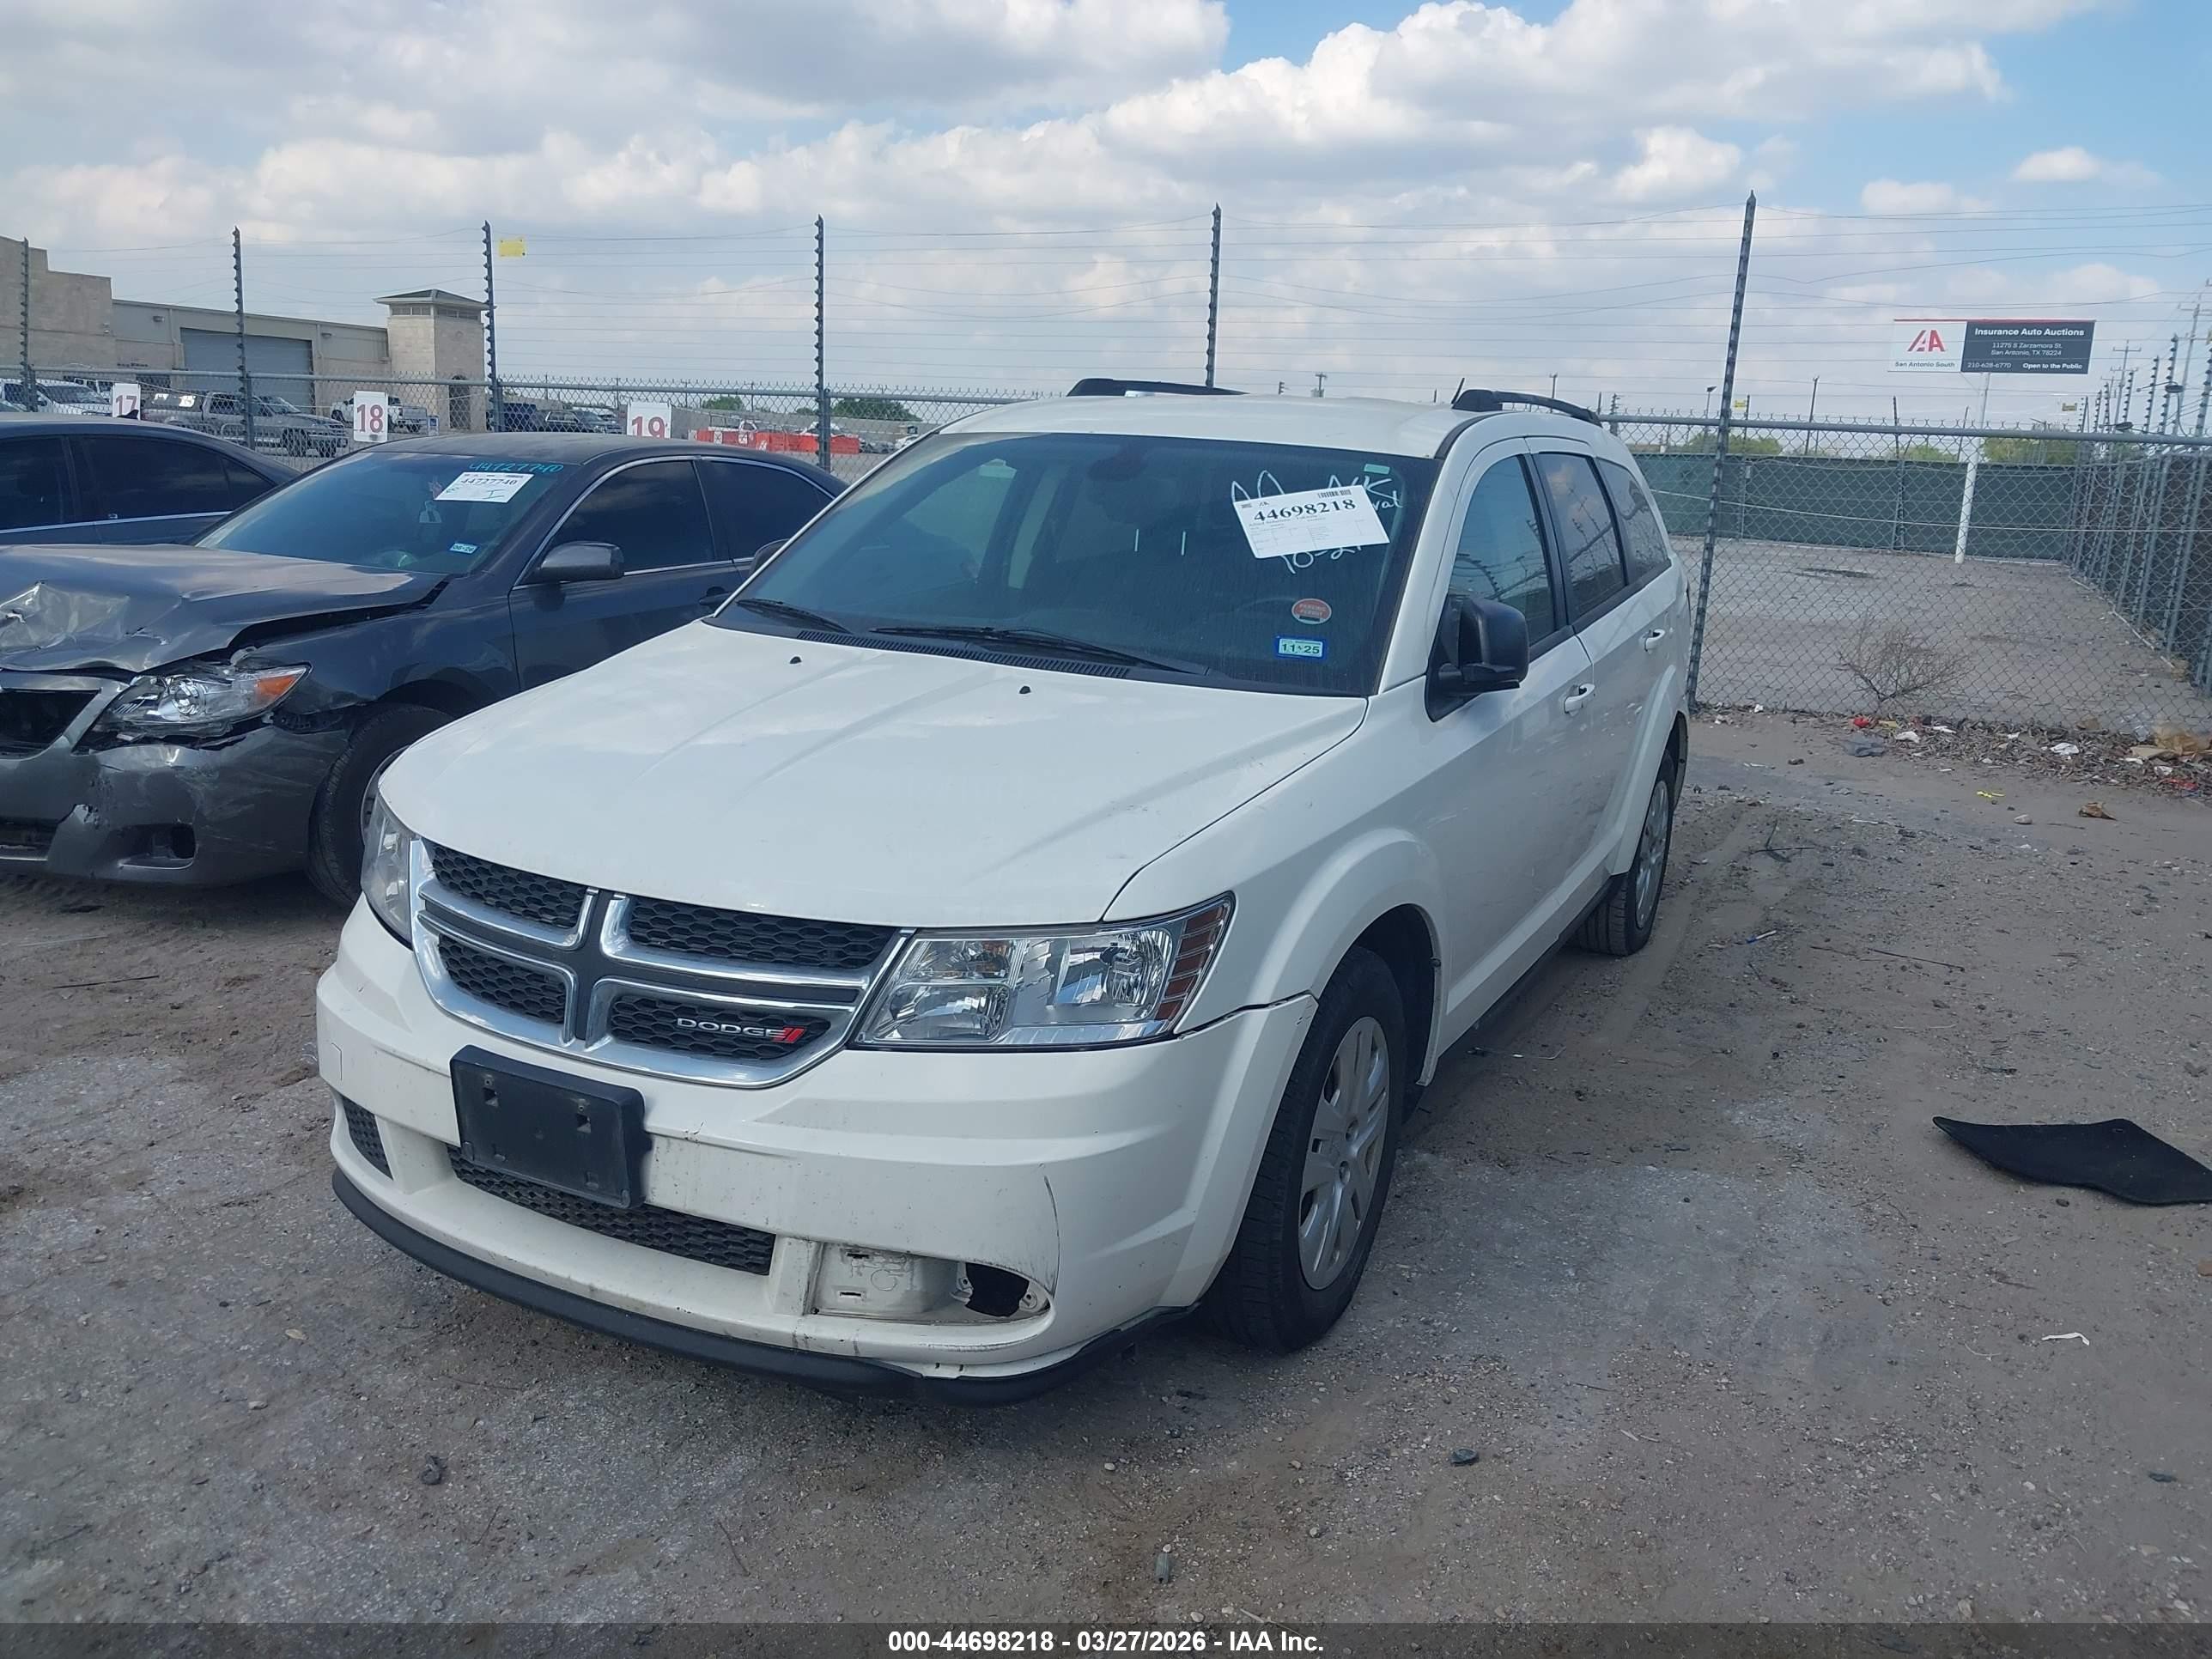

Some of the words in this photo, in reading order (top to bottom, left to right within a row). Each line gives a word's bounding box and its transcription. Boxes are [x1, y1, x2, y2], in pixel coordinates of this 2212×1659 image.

[116, 395, 137, 415] 17
[357, 404, 384, 434] 18
[631, 416, 665, 439] 19
[1254, 498, 1357, 522] 44698218
[677, 1018, 787, 1038] DODGE
